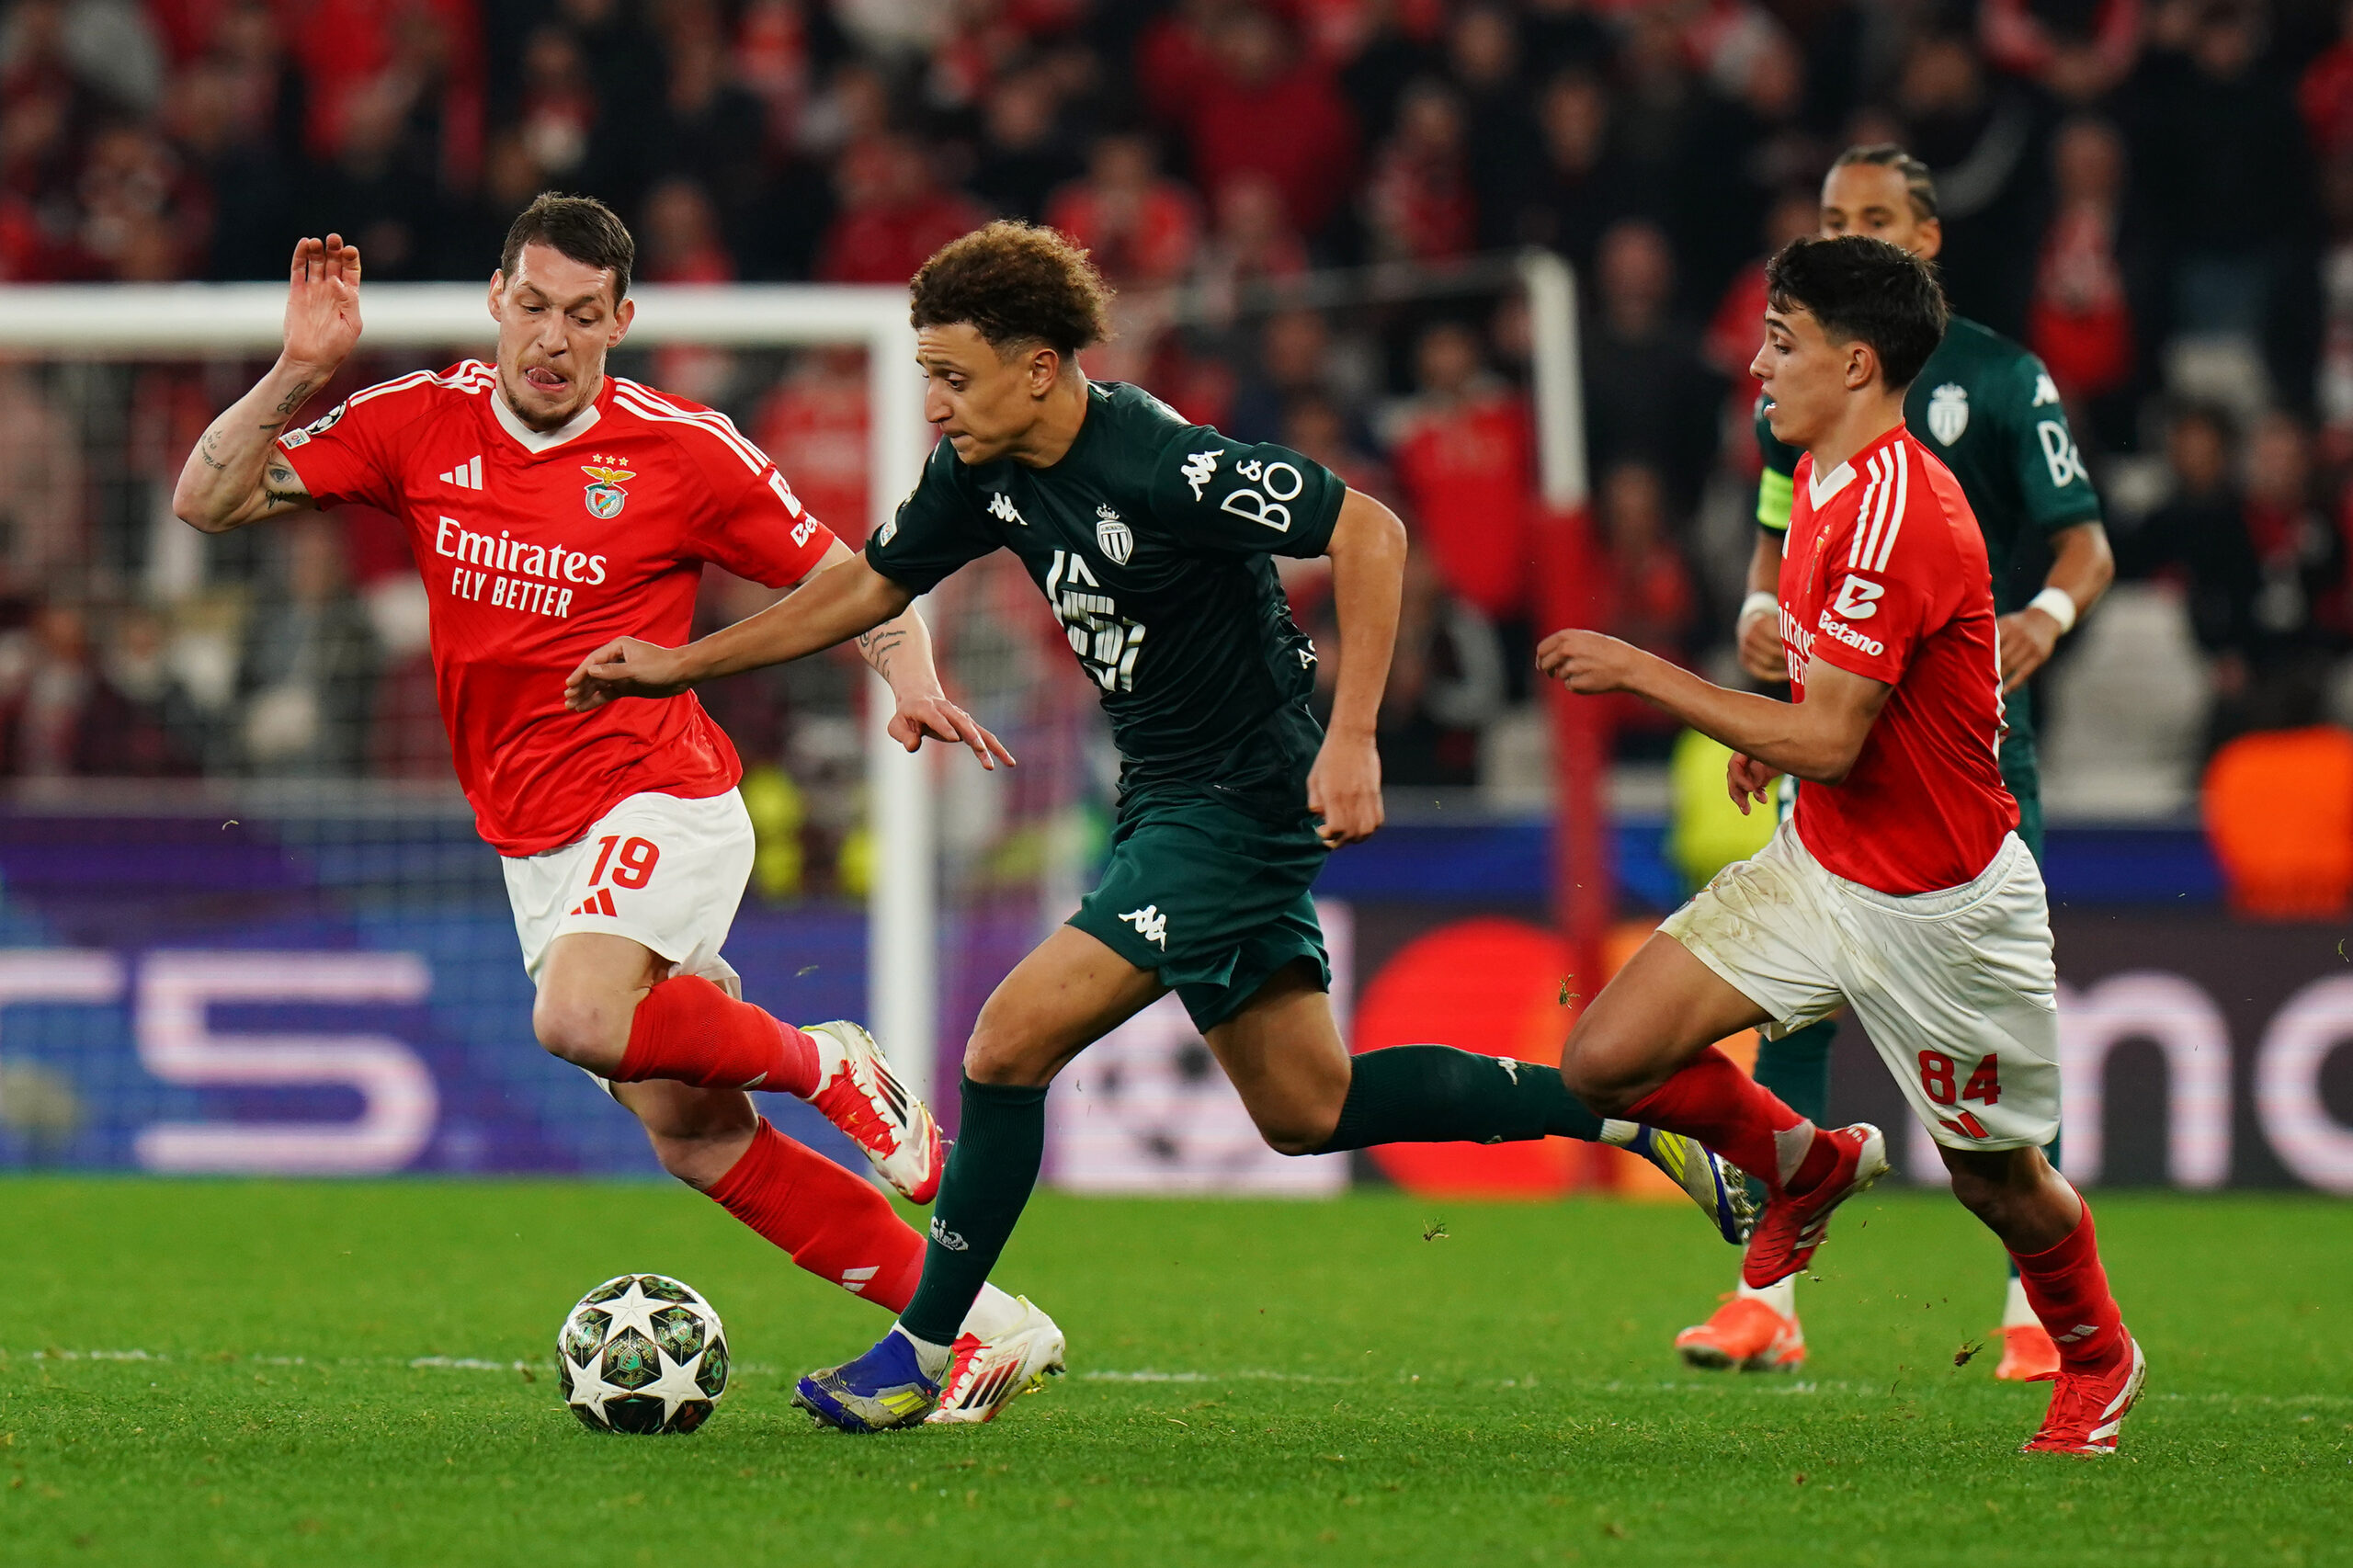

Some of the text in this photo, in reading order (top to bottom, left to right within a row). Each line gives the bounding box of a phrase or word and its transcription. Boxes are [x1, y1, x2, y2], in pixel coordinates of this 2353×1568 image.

[436, 516, 608, 585] Emirates
[451, 567, 574, 619] FLY BETTER
[1818, 608, 1884, 656] Betano
[588, 835, 660, 890] 19
[1918, 1050, 2002, 1107] 84
